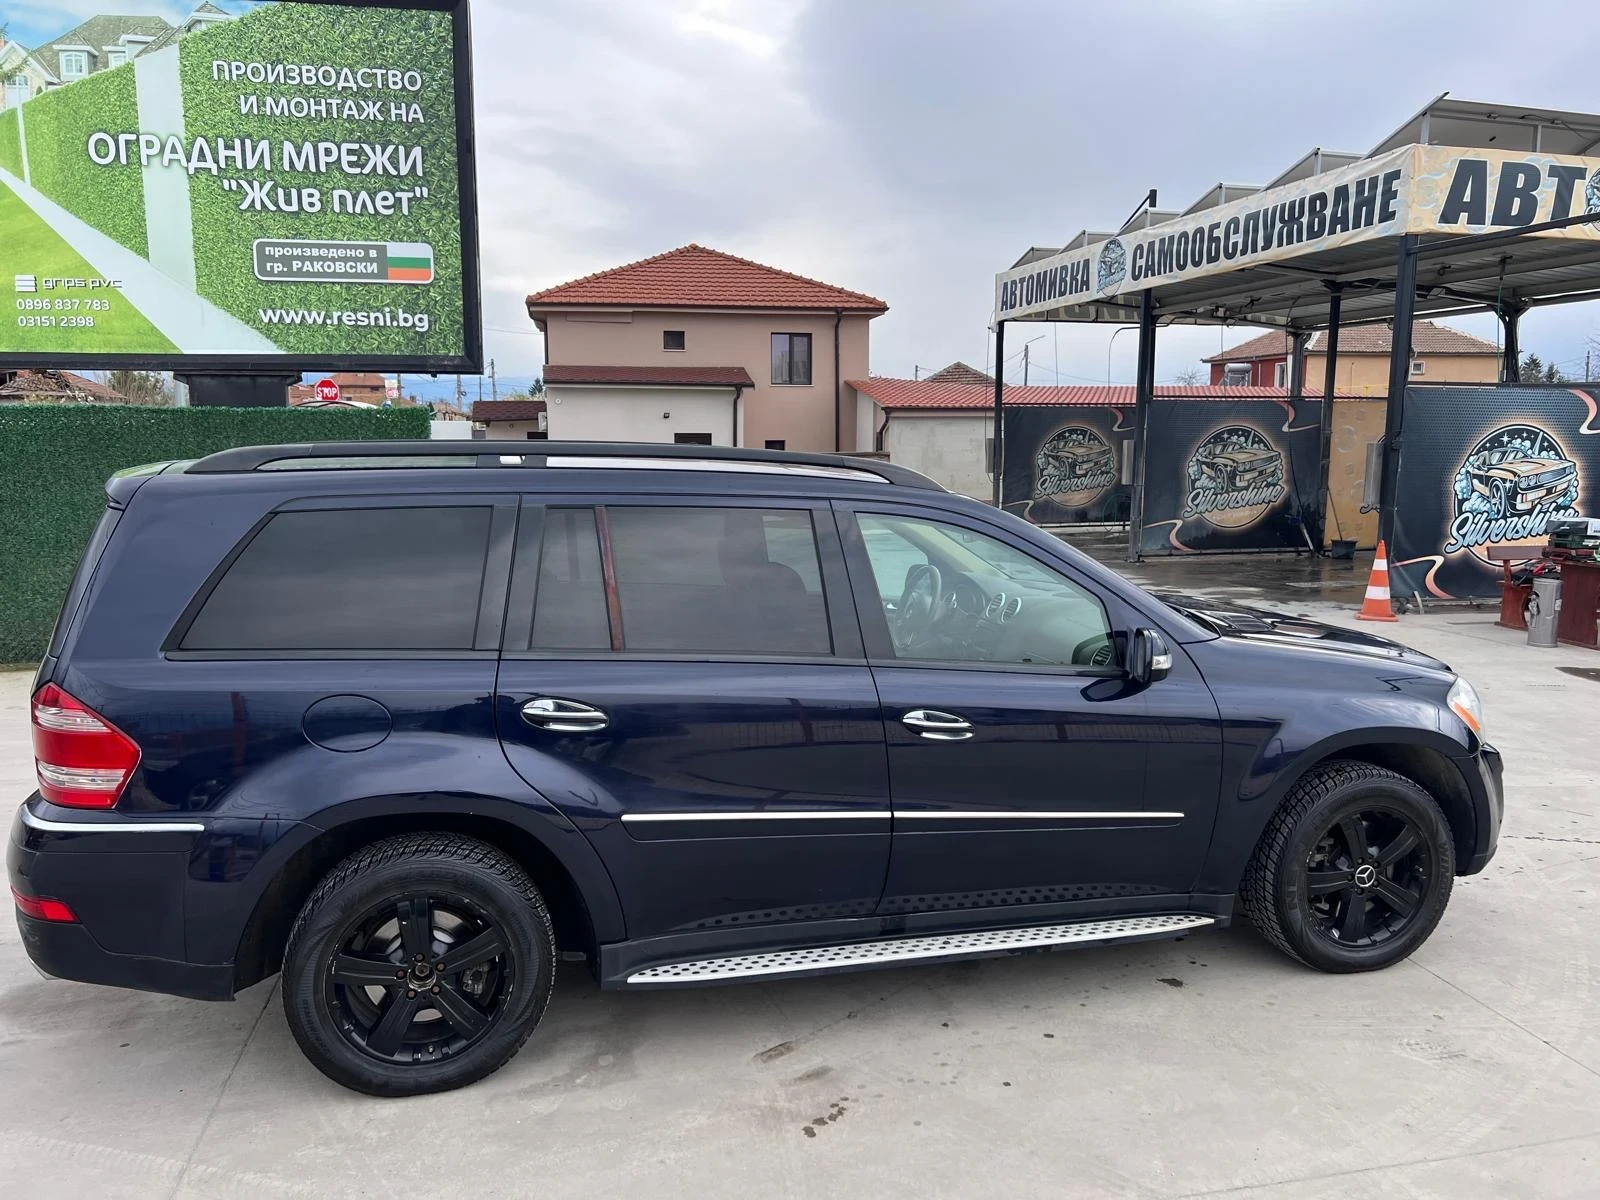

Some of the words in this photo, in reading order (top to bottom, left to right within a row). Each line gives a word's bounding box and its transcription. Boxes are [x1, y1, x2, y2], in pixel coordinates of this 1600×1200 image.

[212, 60, 423, 93] ПРОИЗВОДСТВО
[238, 94, 258, 115] И
[265, 97, 384, 121] МОНТАЖ
[390, 102, 425, 123] НА
[87, 132, 271, 175] ОГРАДНИ
[283, 141, 423, 177] МРЕЖИ
[222, 178, 322, 213] "Жив
[332, 186, 429, 217] плет"
[1437, 158, 1588, 227] АВТ
[1131, 168, 1402, 283] САМООБСЛУЖВАНЕ
[264, 246, 365, 259] произведено
[369, 249, 378, 258] в
[266, 262, 288, 275] гр.
[292, 261, 378, 274] РАКОВСКИ
[42, 277, 87, 290] grips
[1000, 257, 1092, 312] АВТОМИВКА
[16, 298, 52, 311] 0896
[54, 298, 81, 311] 837
[84, 299, 111, 312] 783
[17, 315, 57, 327] 03151
[60, 316, 95, 328] 2398
[258, 307, 430, 333] www.resni.bg
[316, 386, 338, 398] STOP
[1034, 470, 1116, 499] Silvershine
[1183, 482, 1285, 518] Silvershine
